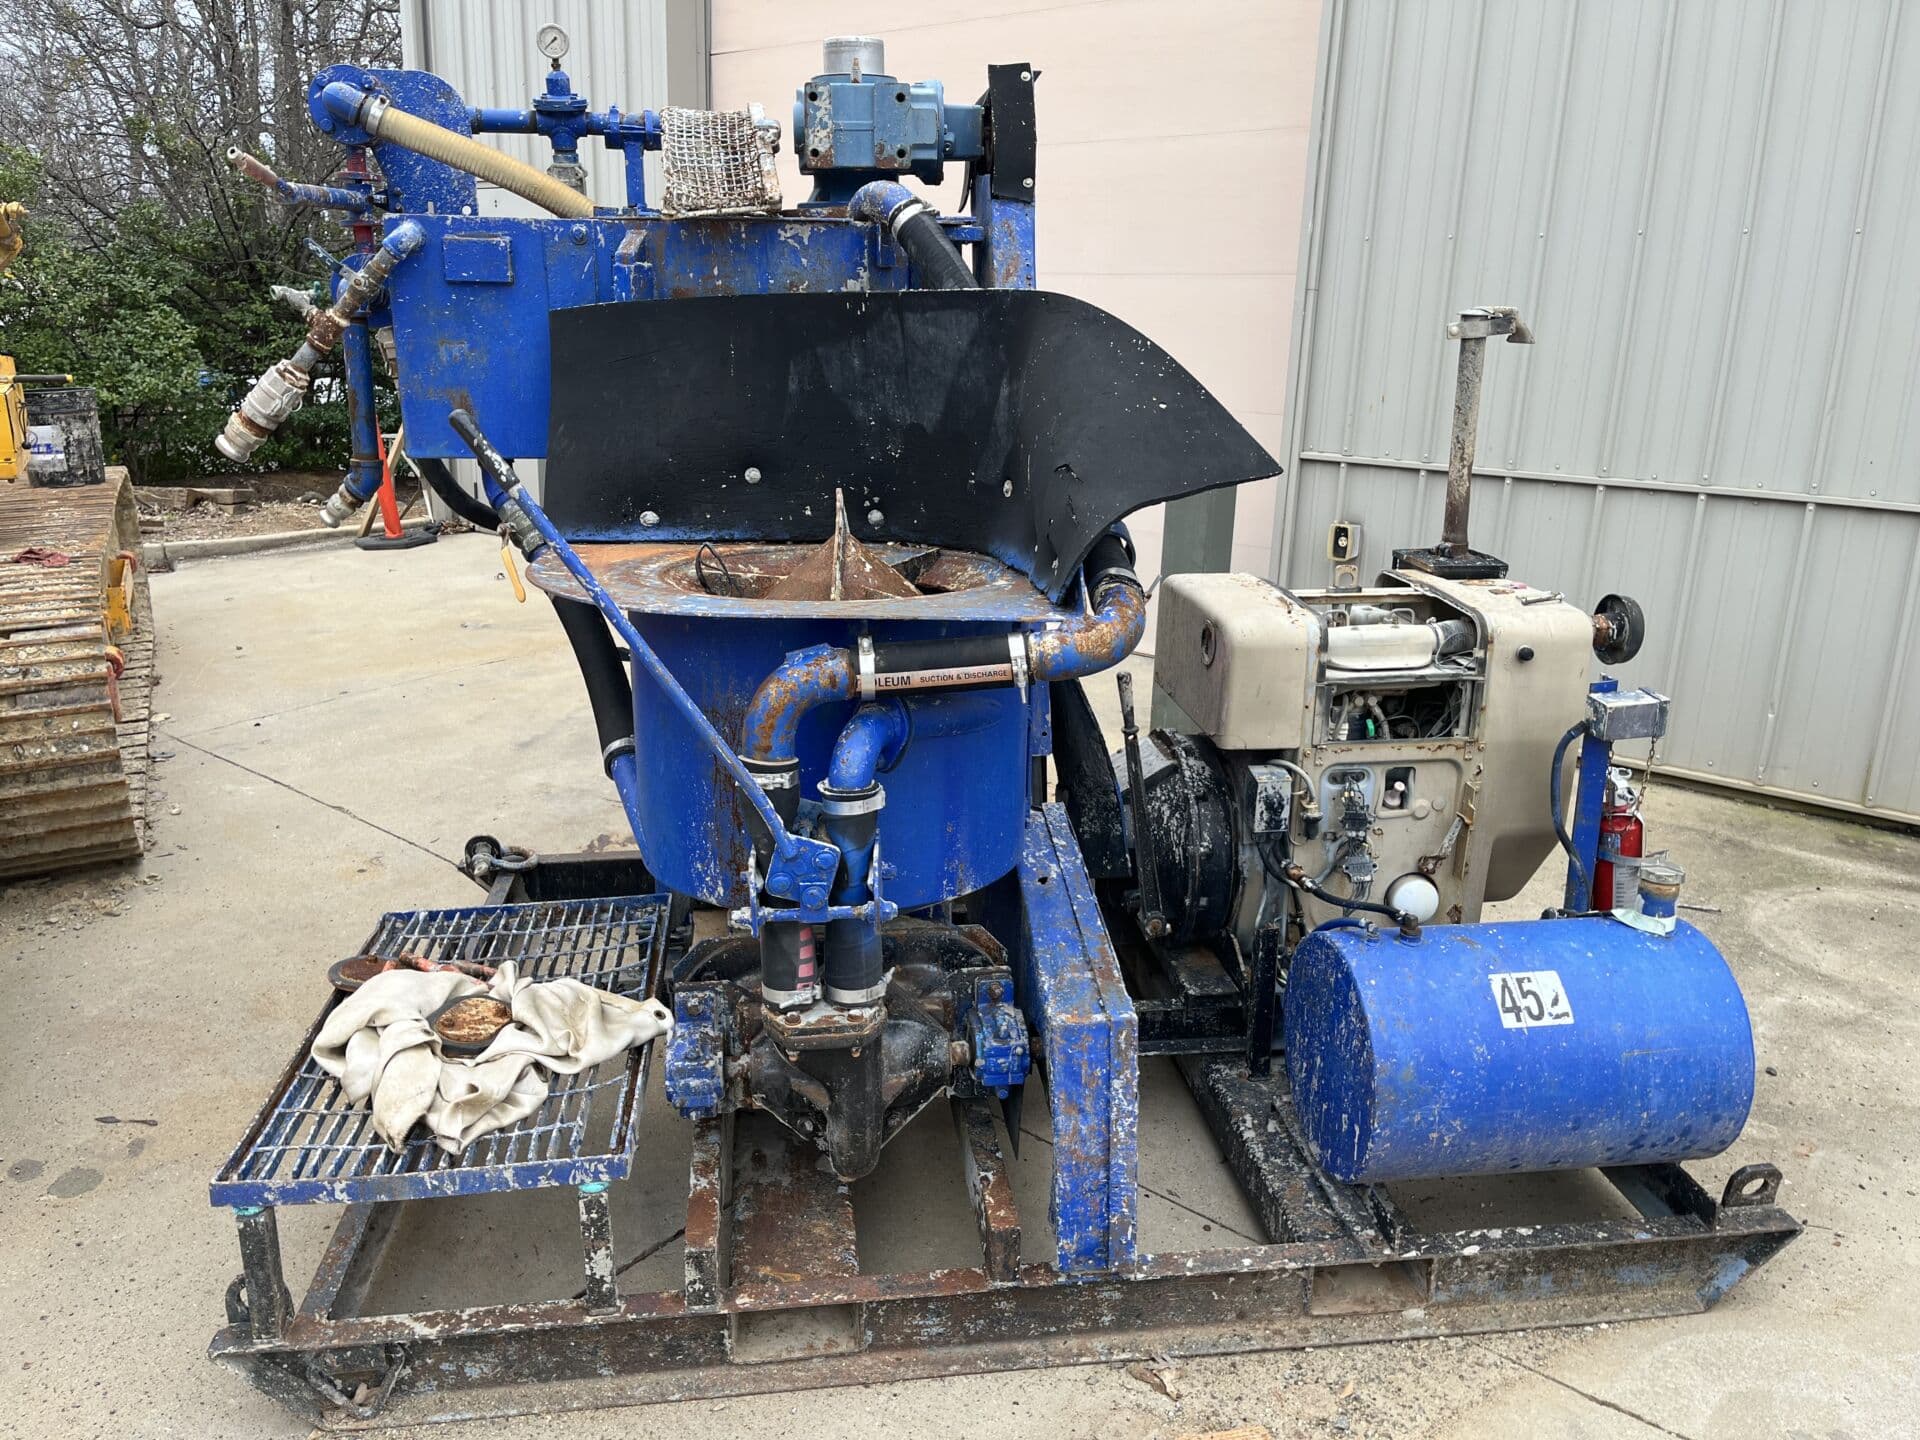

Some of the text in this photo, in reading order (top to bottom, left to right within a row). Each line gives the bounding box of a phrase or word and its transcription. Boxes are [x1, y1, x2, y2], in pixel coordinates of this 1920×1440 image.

[919, 674, 954, 683] SUCTION
[956, 673, 962, 681] &
[964, 669, 1008, 680] DISCHARGE
